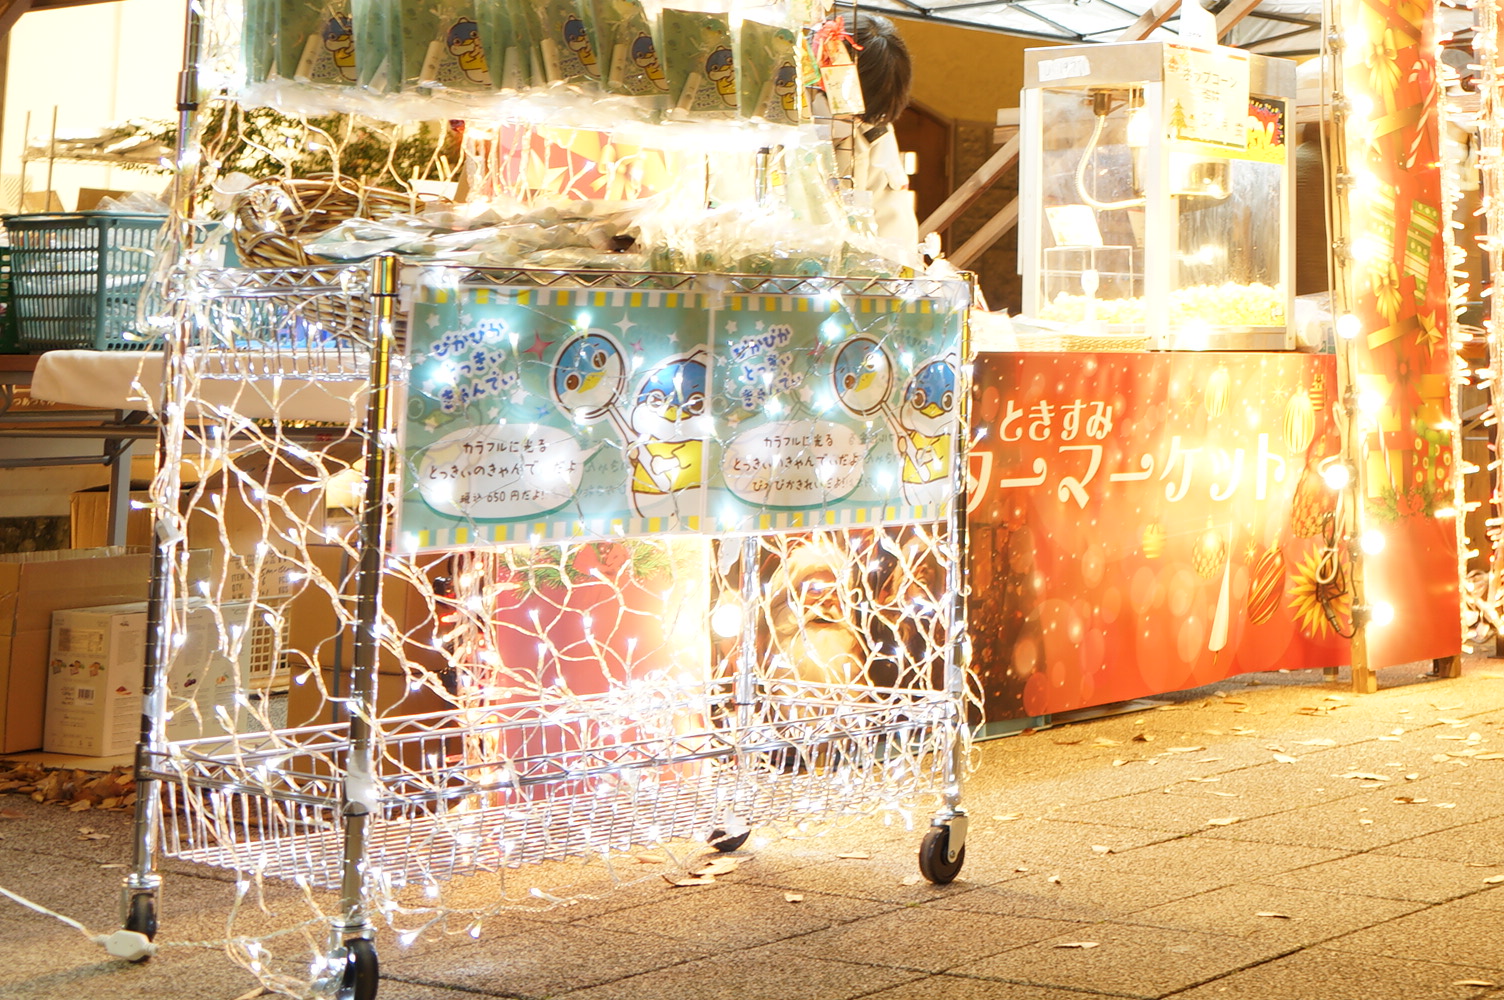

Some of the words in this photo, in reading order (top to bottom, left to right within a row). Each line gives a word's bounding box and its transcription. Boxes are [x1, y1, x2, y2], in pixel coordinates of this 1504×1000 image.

[1000, 399, 1113, 442] ときすみ
[763, 433, 833, 448] カラフルに光る
